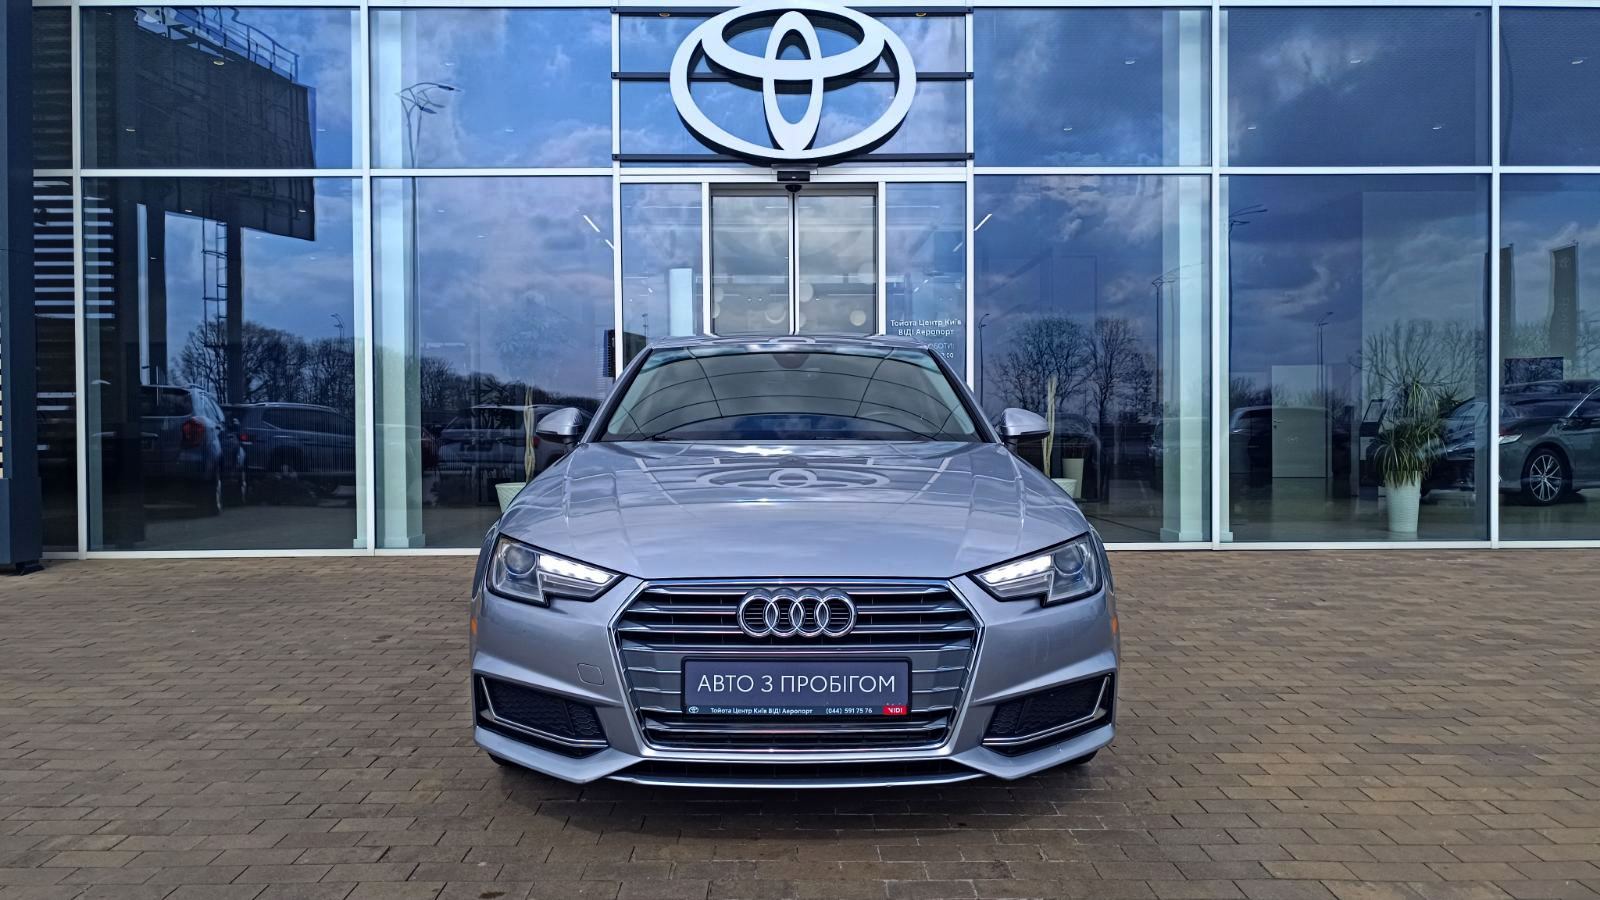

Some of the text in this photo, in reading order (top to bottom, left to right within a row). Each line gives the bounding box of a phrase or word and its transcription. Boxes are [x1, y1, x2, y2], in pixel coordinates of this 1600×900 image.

[890, 319, 917, 327] Тойота
[918, 319, 943, 328] Центр
[915, 328, 954, 337] Аеропорт
[697, 674, 895, 693] АВТО З ПРОБІГОМ
[732, 707, 753, 715] Центр
[825, 707, 842, 715] (044)
